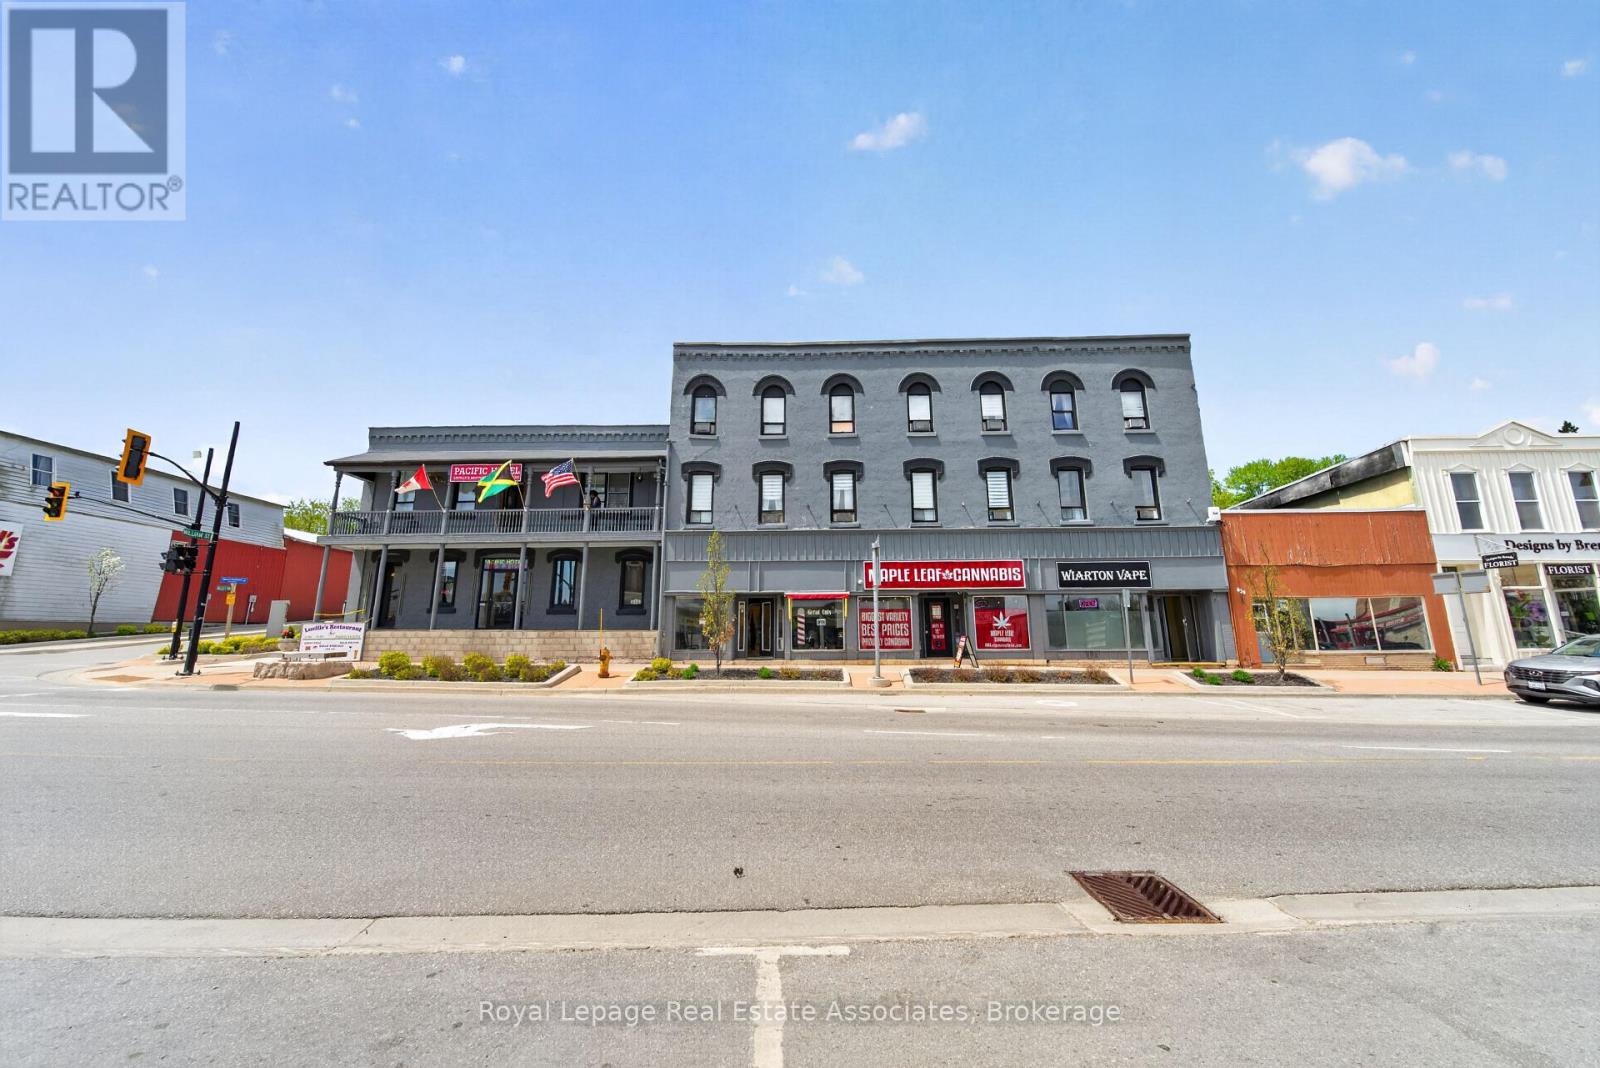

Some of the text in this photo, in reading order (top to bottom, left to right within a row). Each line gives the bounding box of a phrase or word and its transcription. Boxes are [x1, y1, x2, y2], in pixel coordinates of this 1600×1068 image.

[454, 467, 488, 475] PACIFIC
[1504, 539, 1554, 553] Designs
[1555, 539, 1571, 553] by
[1484, 560, 1517, 569] FLORIST
[914, 568, 942, 582] LEAF
[953, 567, 1022, 582] CANNABIS
[1060, 569, 1148, 581] WIARTON VAPE
[1547, 565, 1590, 575] FLORIST
[886, 612, 909, 621] VARIETY
[330, 624, 362, 632] Restaurant
[861, 624, 909, 637] BES PRICES
